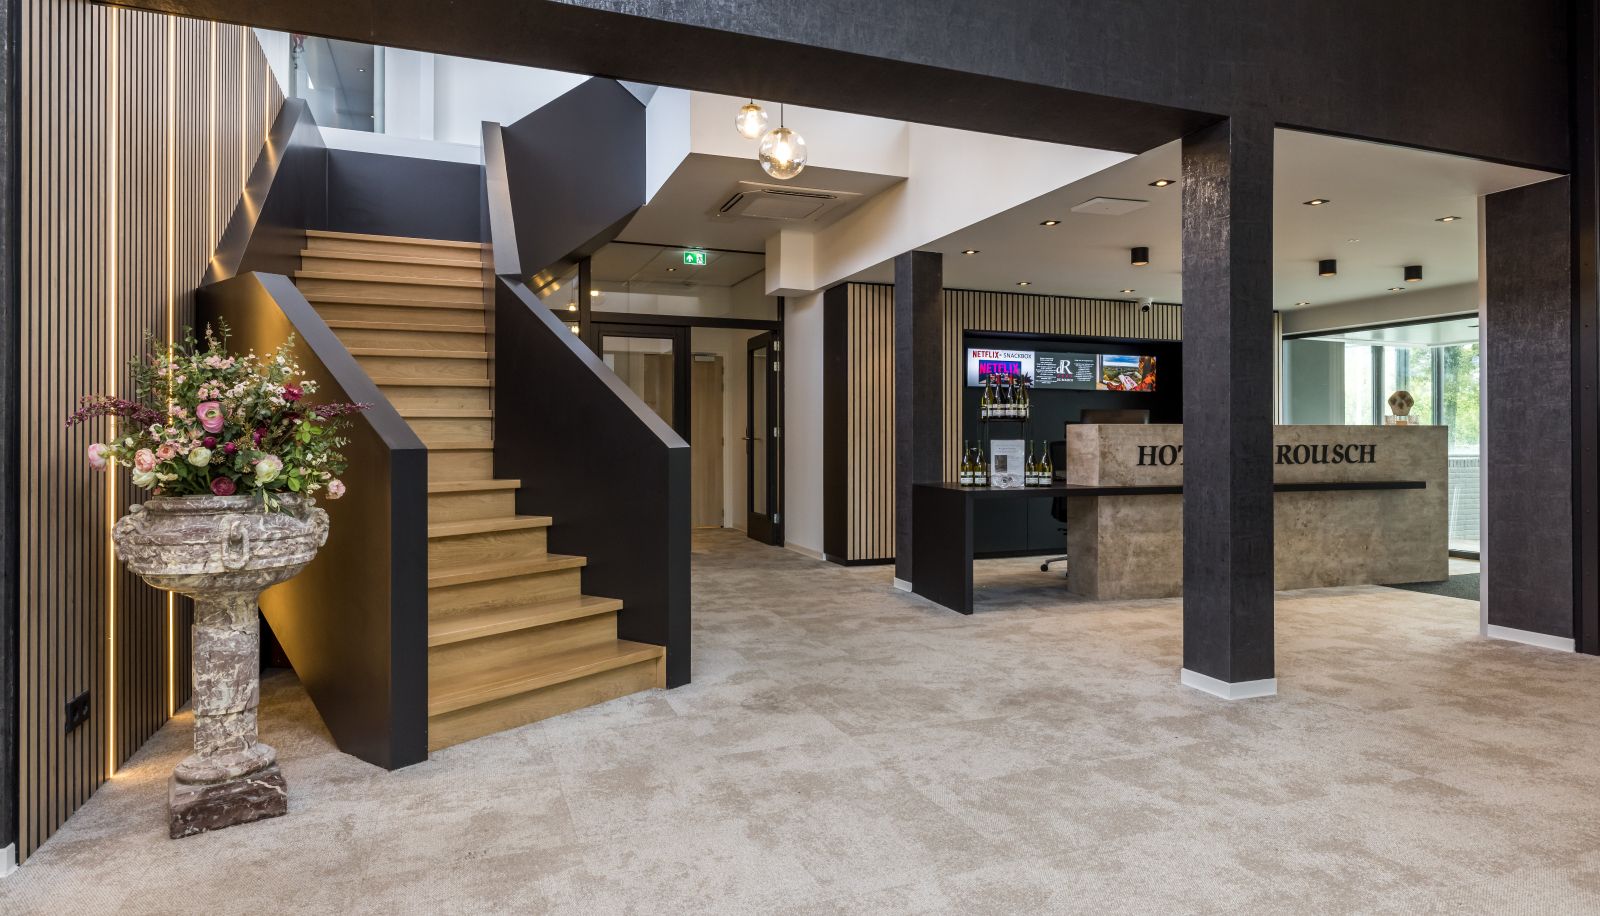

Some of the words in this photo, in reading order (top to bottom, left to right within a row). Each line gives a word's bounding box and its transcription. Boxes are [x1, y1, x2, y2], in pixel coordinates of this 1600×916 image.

[972, 350, 999, 359] NETFLIX
[979, 362, 1020, 375] NETFLIX
[1274, 443, 1378, 465] ROUSCH
